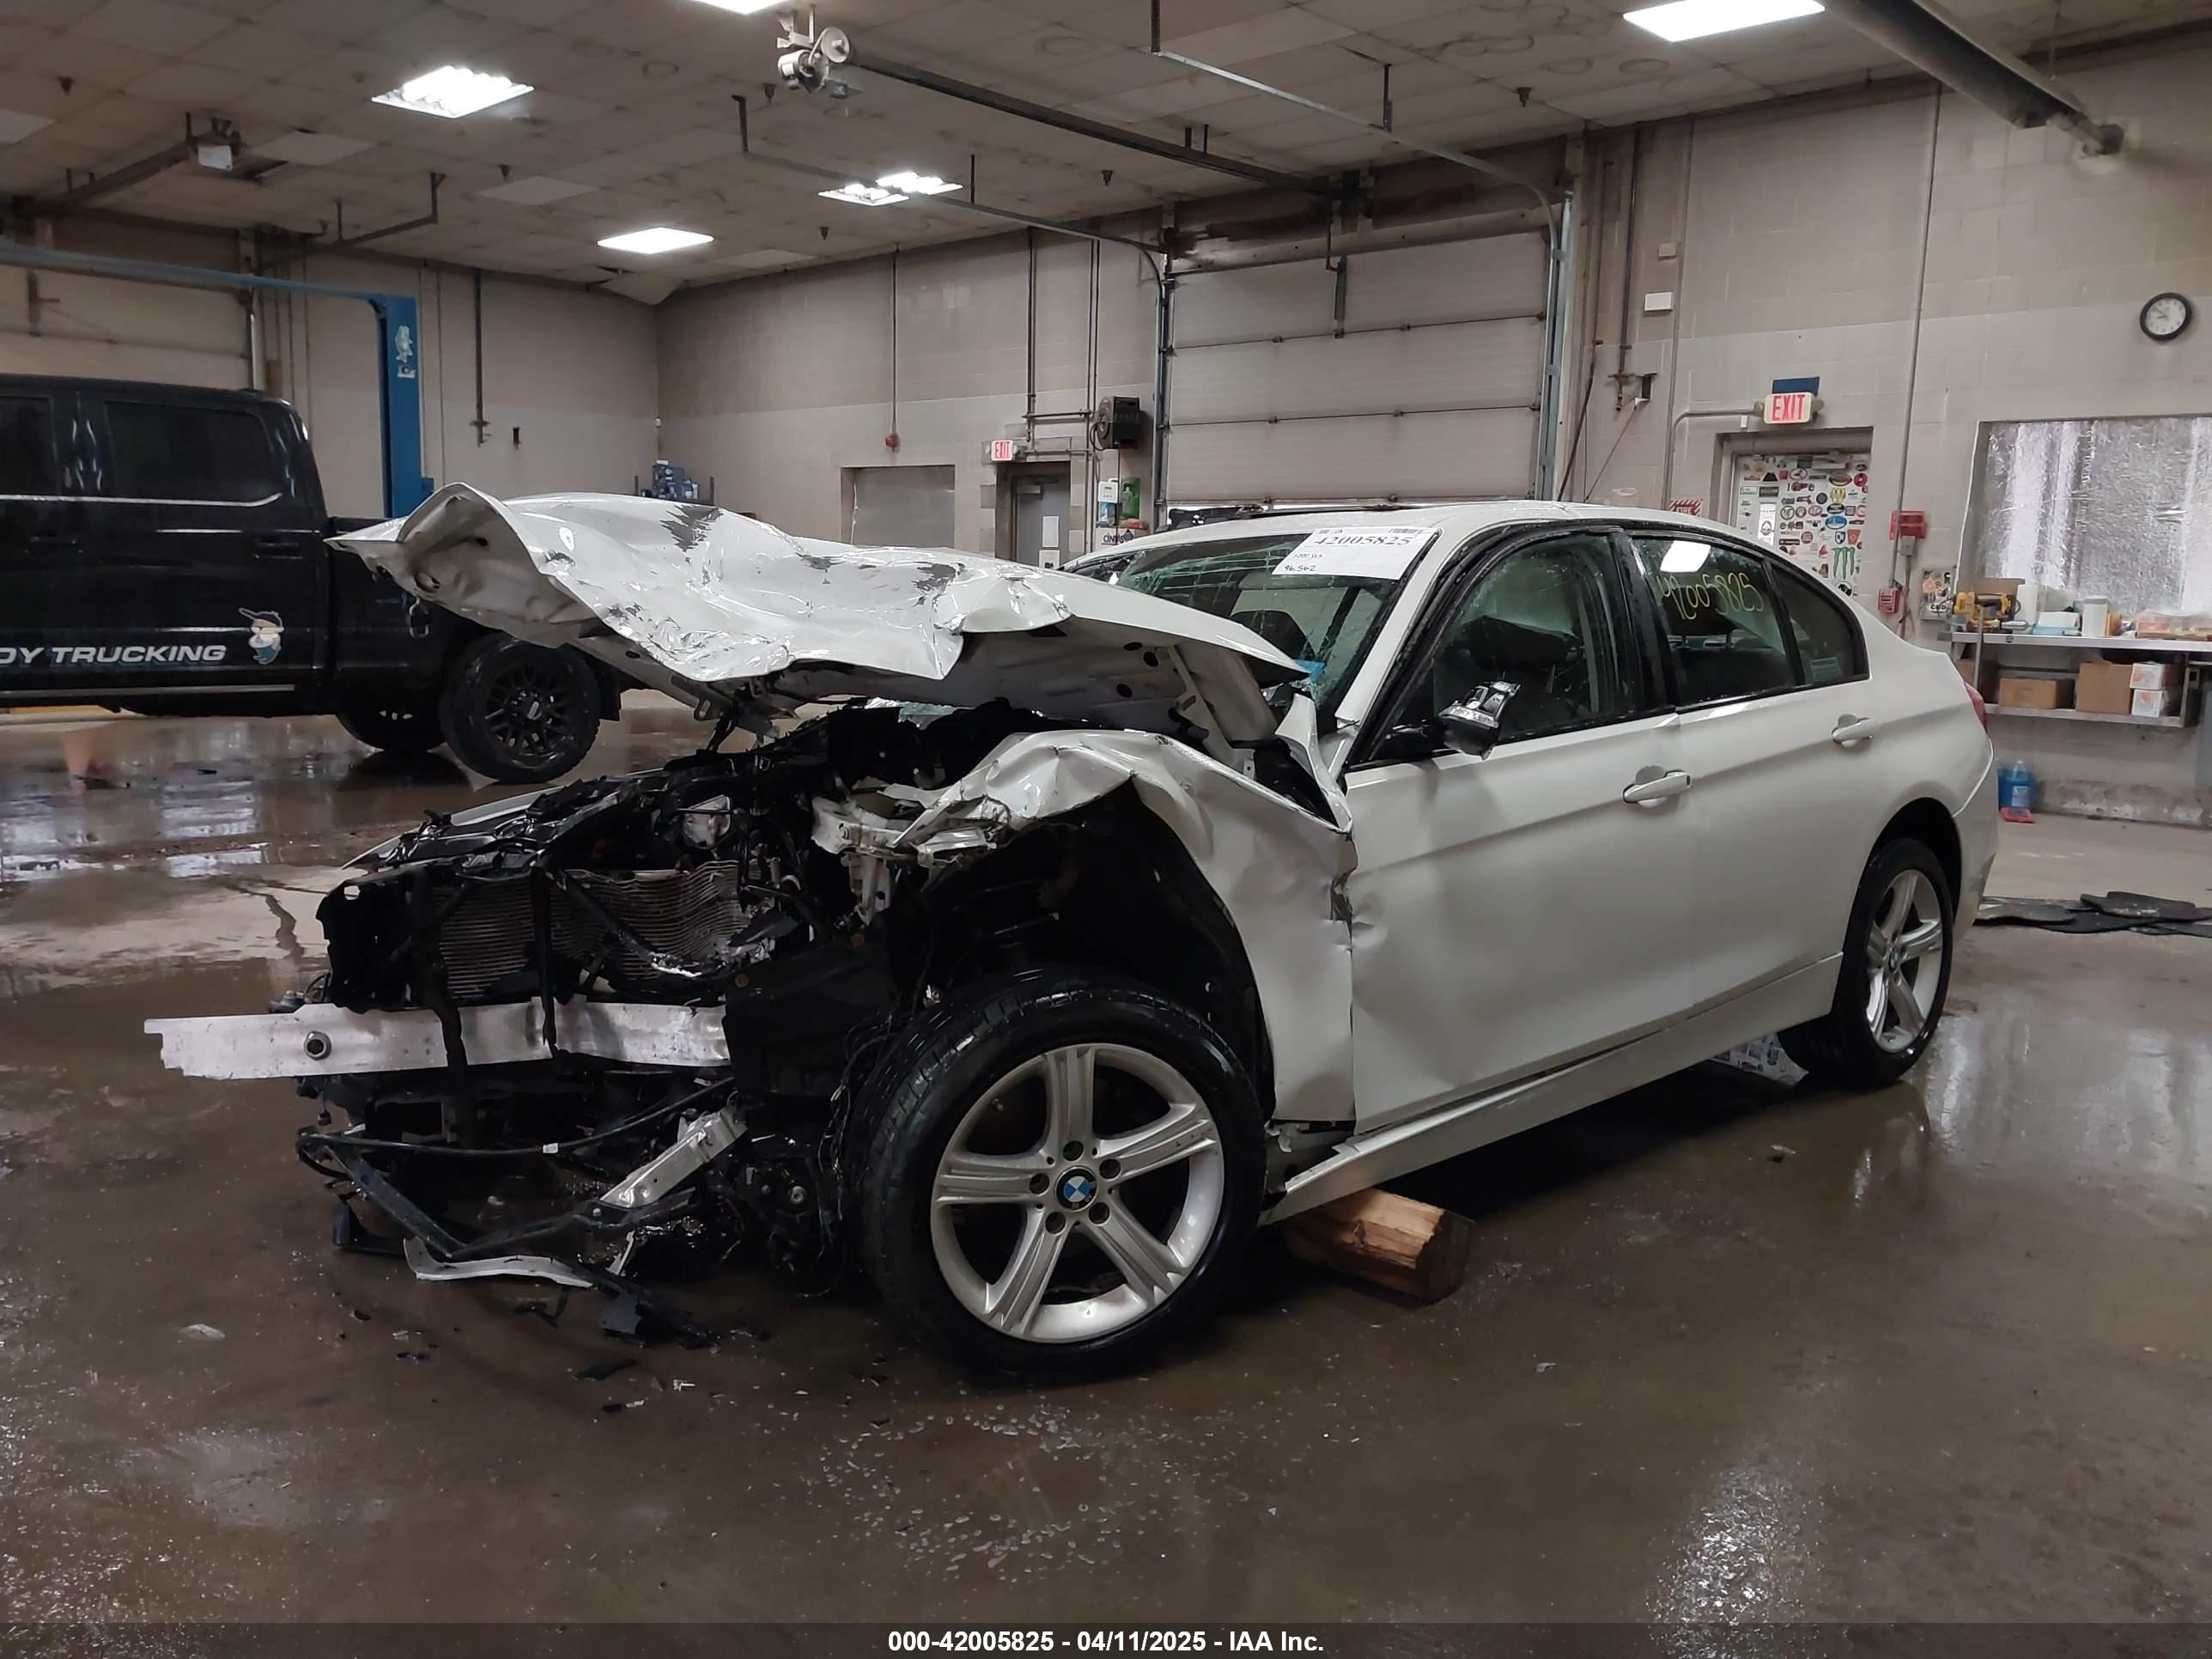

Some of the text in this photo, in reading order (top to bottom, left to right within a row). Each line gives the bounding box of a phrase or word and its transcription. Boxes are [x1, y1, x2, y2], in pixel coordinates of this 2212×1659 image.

[1771, 394, 1806, 421] EXIT
[995, 441, 1011, 459] EXIT
[1315, 536, 1415, 545] 42005825
[1656, 572, 1765, 620] 42005825
[52, 645, 227, 664] TRUCKING
